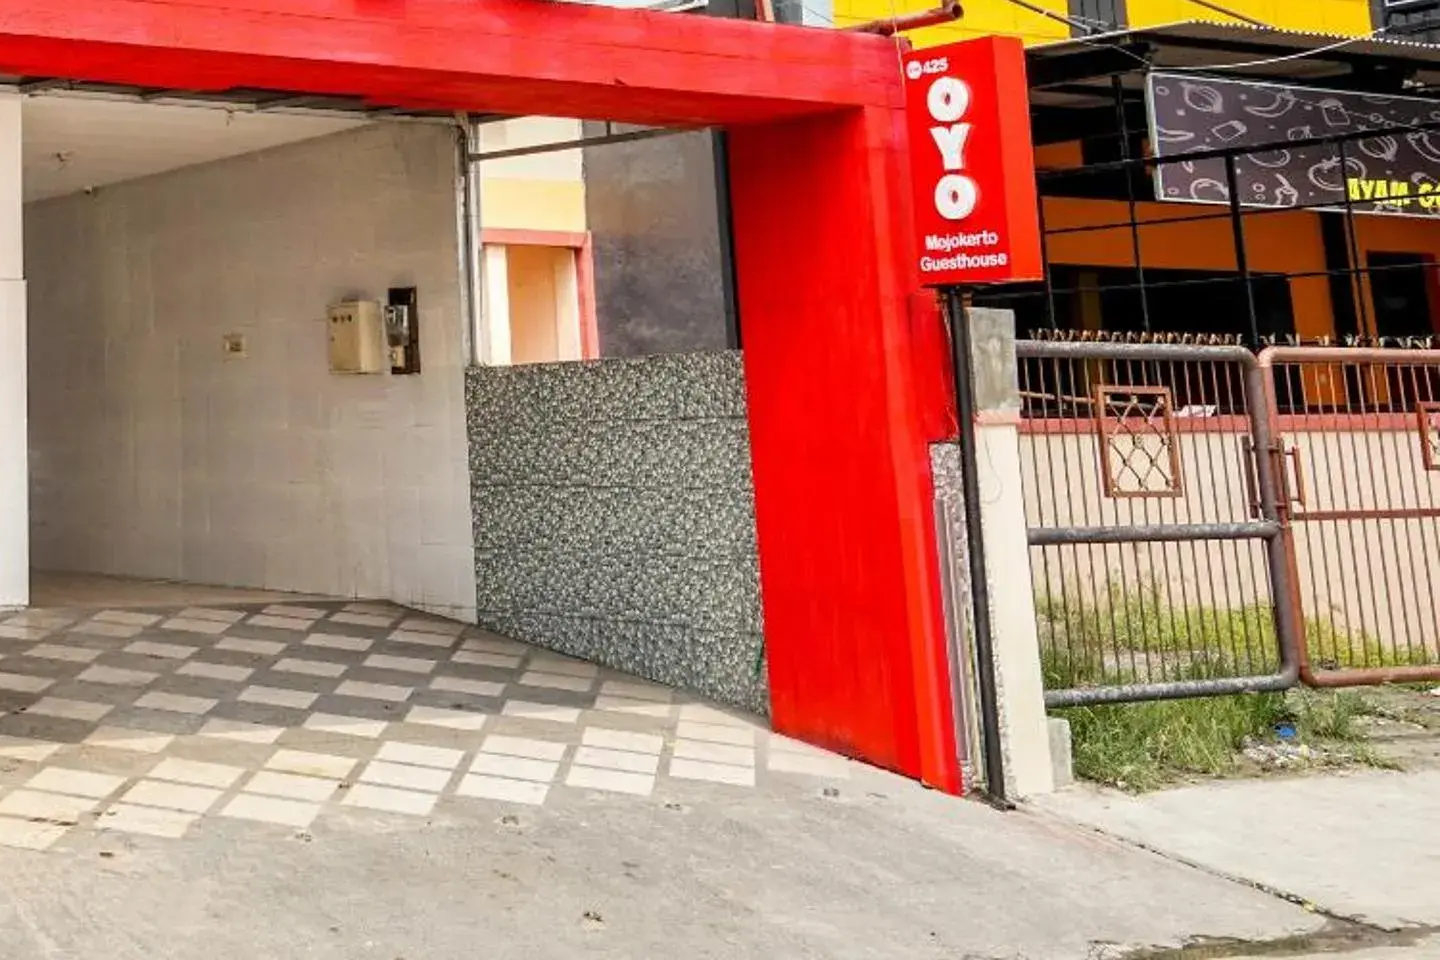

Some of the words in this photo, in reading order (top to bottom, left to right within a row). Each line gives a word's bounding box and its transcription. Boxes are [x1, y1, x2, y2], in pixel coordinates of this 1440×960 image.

[927, 76, 978, 220] OYO
[924, 230, 999, 252] Mojokerto
[920, 253, 1008, 272] Guesthouse
